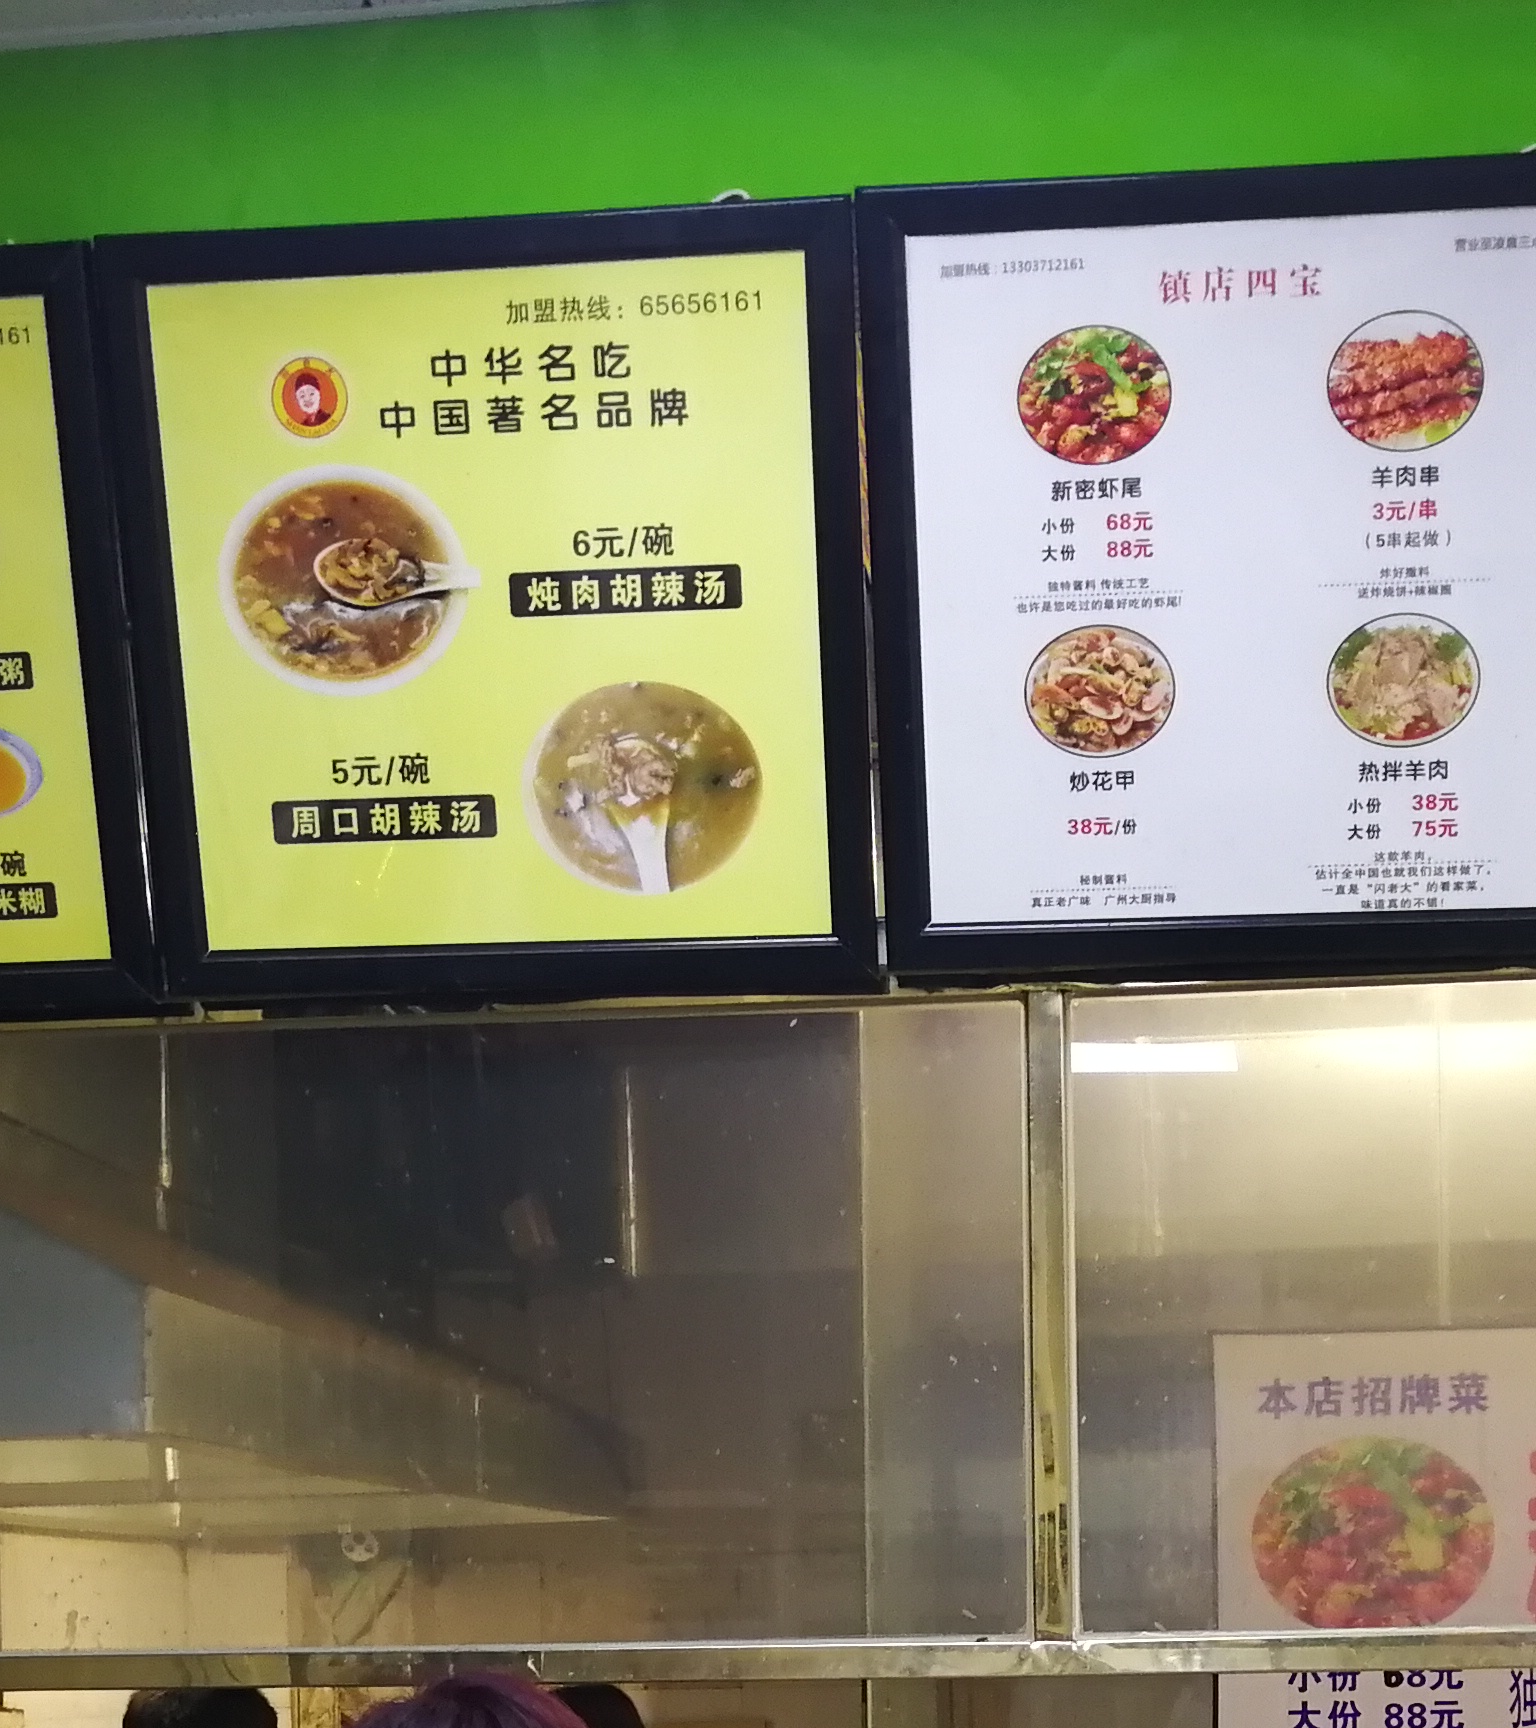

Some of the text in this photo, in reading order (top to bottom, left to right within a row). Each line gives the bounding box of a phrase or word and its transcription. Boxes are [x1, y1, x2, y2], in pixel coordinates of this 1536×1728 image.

[1160, 264, 1321, 303] 镇店四宝
[506, 290, 761, 324] 加盟热线：65656161
[430, 341, 630, 387] 中华名吃
[380, 389, 688, 438] 中国著名品牌
[1372, 465, 1439, 488] 羊肉串
[1052, 477, 1141, 501] 新密虾尾
[1373, 498, 1437, 521] 3元/串
[1042, 512, 1153, 535] 小份 68元
[573, 523, 674, 559] 6元/碗
[1042, 539, 1153, 562] 大份 88元
[525, 570, 727, 614] 炖肉胡辣汤
[332, 753, 430, 787] 5元/碗
[1070, 770, 1134, 792] 炒花甲
[1359, 760, 1448, 782] 热拌羊肉
[1348, 792, 1458, 814] 小份 38元
[292, 800, 484, 841] 周口胡辣汤
[1068, 817, 1137, 836] 38元/份
[1348, 819, 1458, 840] 大份 75元
[1258, 1372, 1490, 1418] 本店招牌菜
